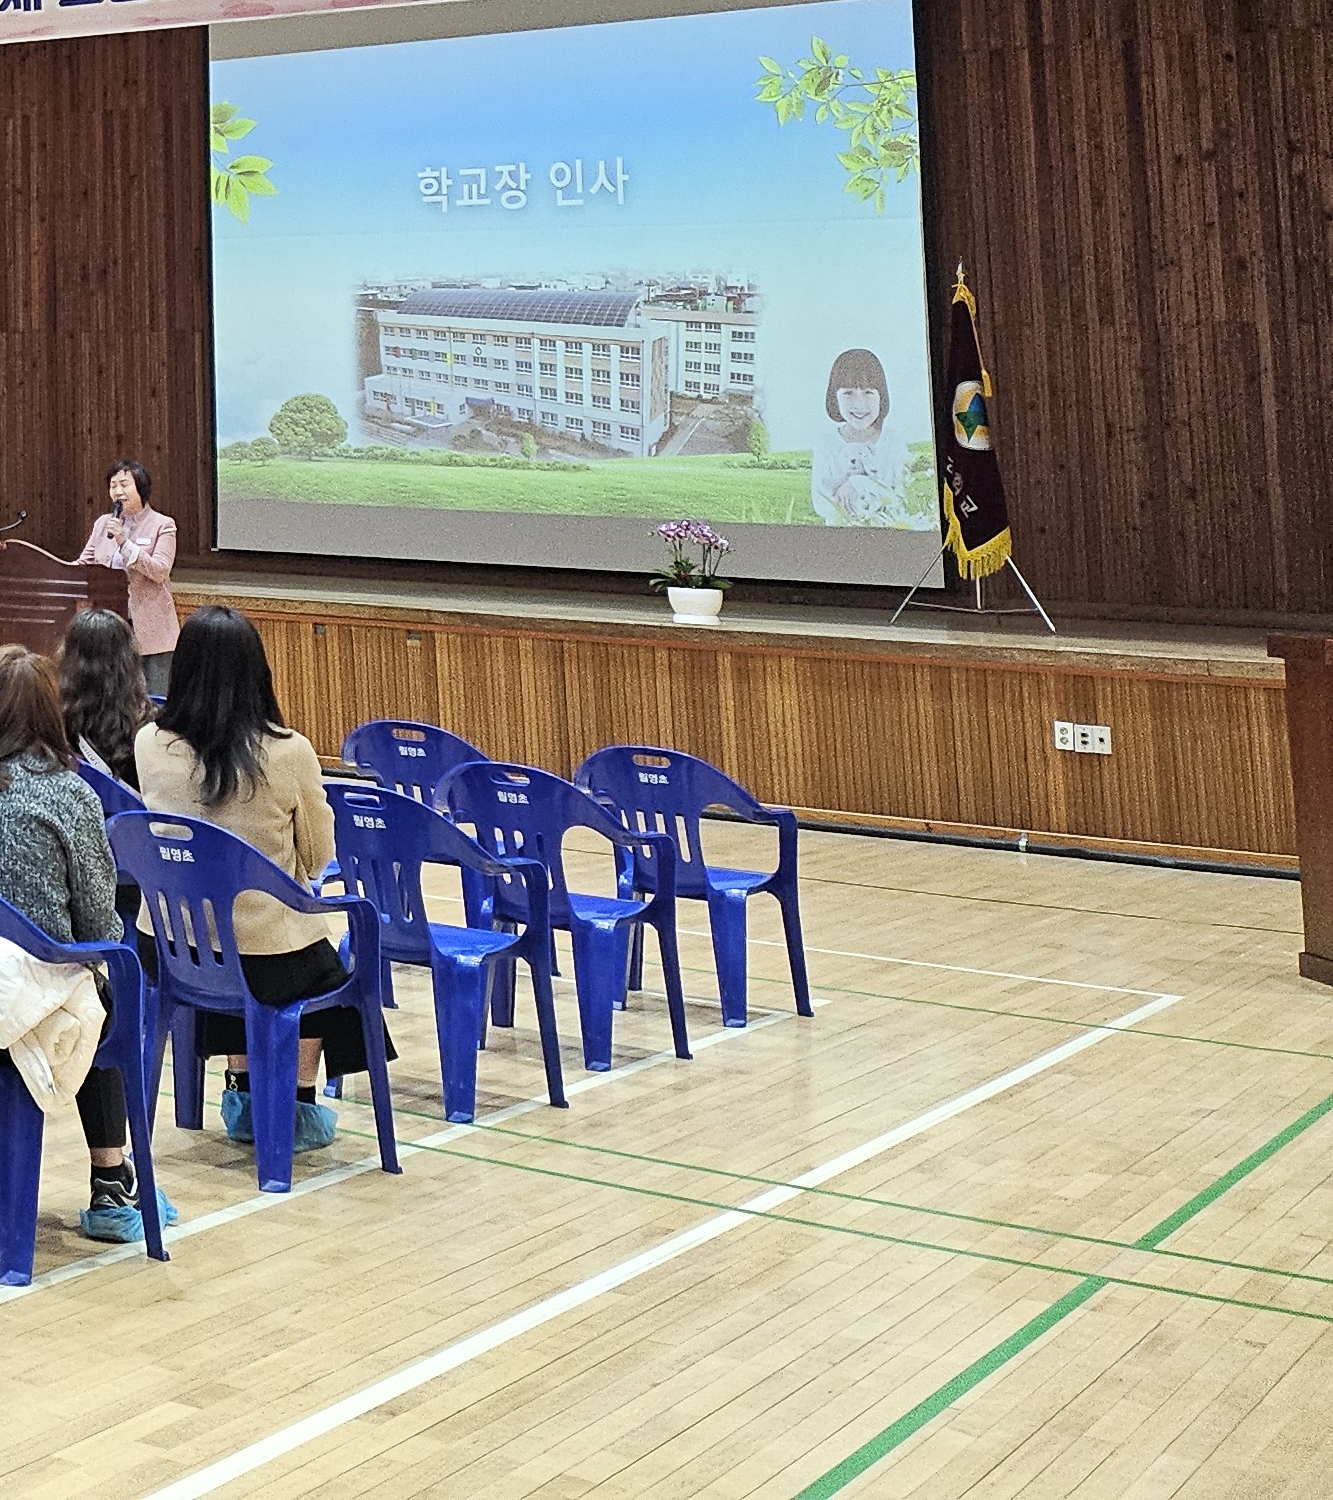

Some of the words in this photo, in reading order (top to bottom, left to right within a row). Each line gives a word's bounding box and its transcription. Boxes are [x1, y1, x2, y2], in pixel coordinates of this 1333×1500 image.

[417, 161, 532, 212] 학교장
[549, 156, 630, 206] 인사
[353, 814, 387, 829] 월영초
[159, 846, 195, 863] 월영초
